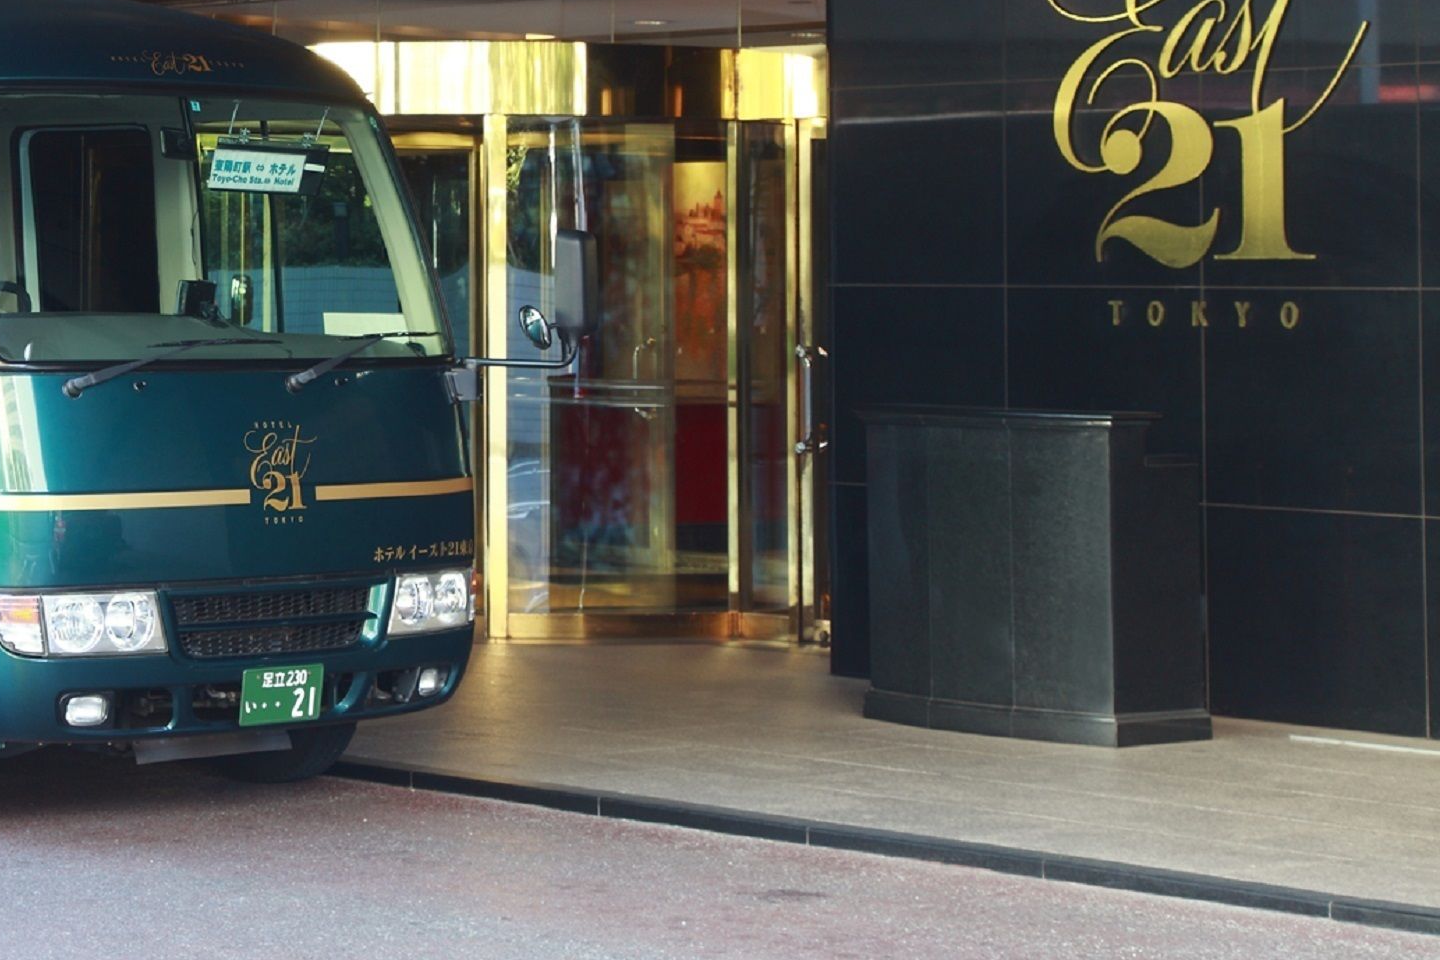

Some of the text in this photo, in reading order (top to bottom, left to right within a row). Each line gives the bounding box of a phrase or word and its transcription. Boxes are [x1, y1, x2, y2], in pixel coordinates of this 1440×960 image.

[269, 162, 297, 177] ホテル
[273, 177, 295, 187] Hotel
[1095, 97, 1317, 269] 21
[1107, 300, 1300, 329] TOKYO
[254, 420, 293, 430] HOTEL
[243, 424, 318, 489] East
[262, 470, 308, 512] 21
[373, 545, 406, 563] ホテル
[291, 686, 316, 718] 21
